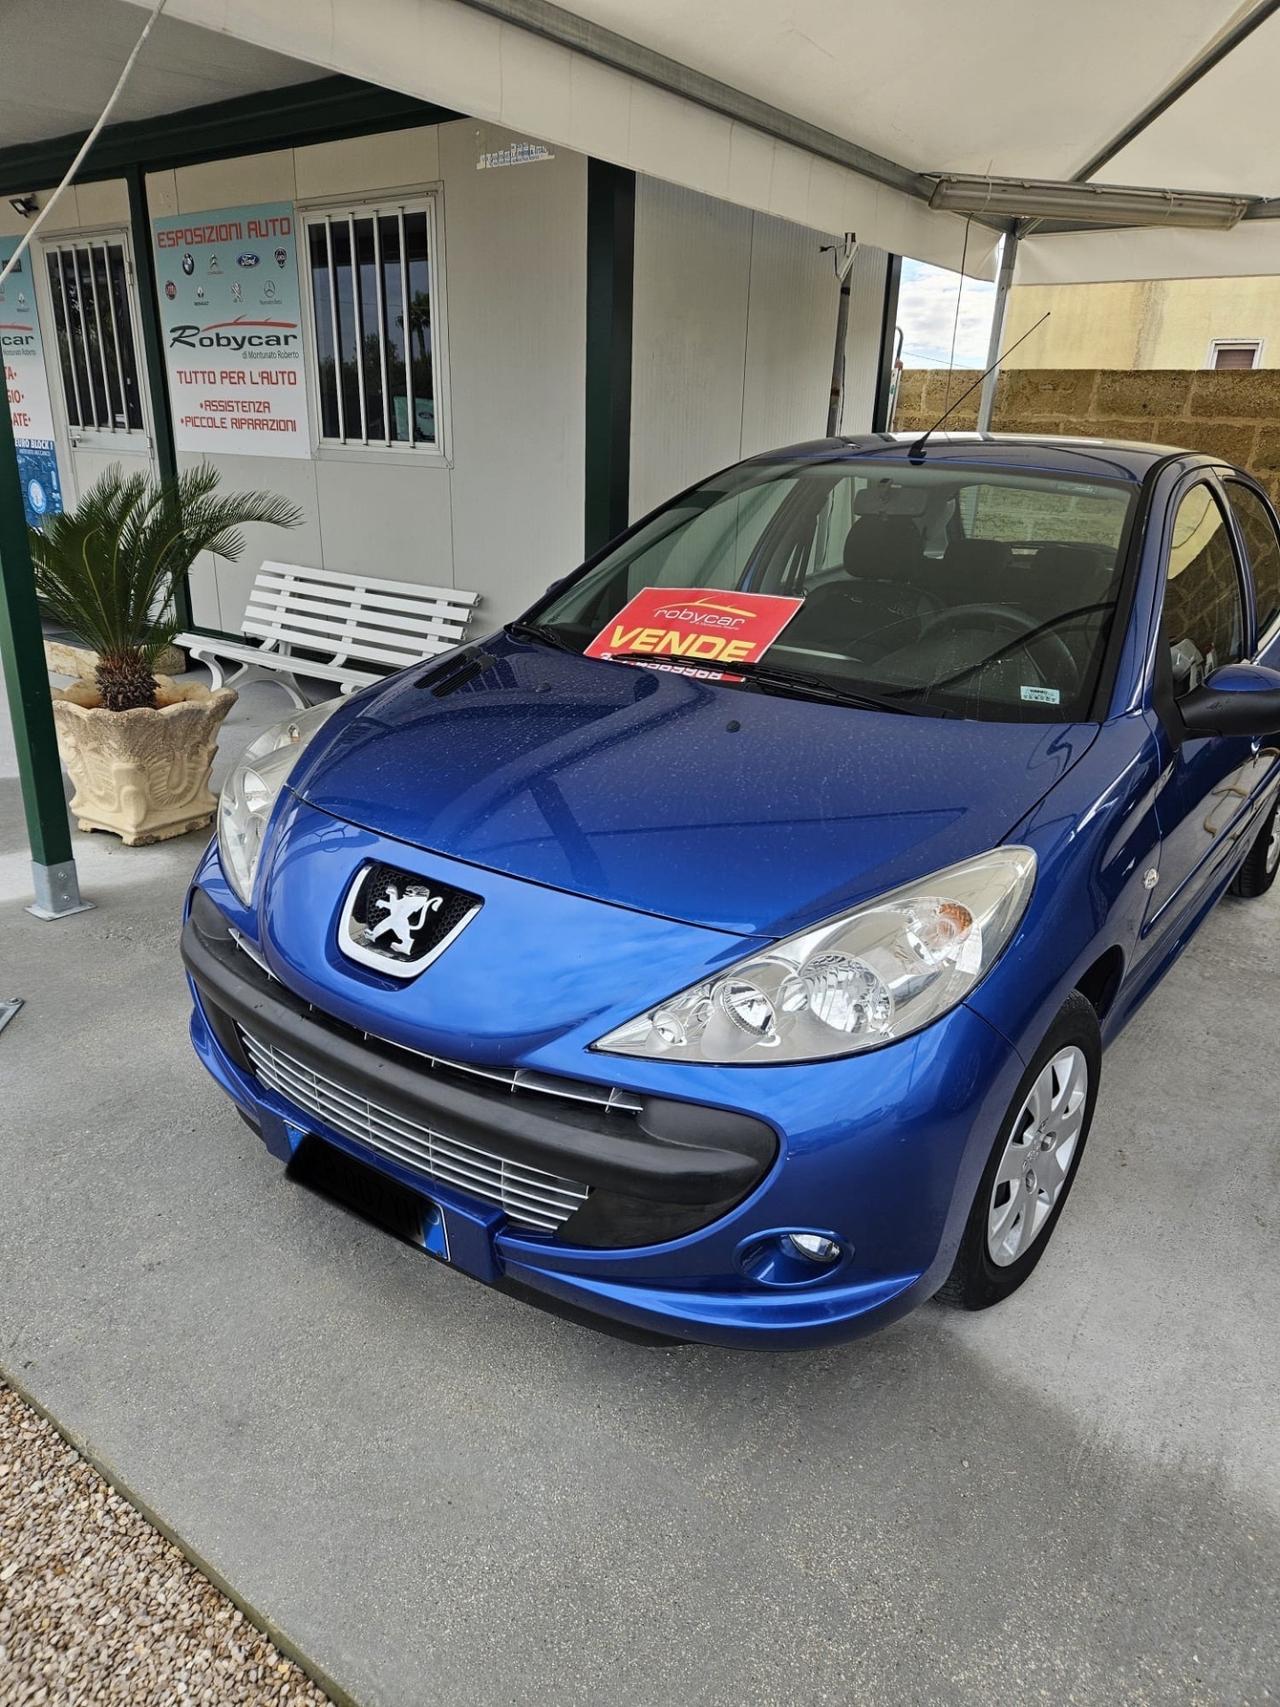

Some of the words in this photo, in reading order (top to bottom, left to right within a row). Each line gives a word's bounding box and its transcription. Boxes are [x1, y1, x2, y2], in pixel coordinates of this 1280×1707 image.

[157, 222, 243, 248] ESPOSIZIONI
[247, 217, 291, 240] AUTO
[169, 325, 298, 351] Robycar
[277, 350, 300, 359] Roberto
[176, 371, 216, 385] TUTTO
[220, 371, 247, 385] PER
[250, 371, 297, 386] L'AUTO
[231, 418, 297, 432] RIPARAZIONI
[654, 608, 745, 627] robycar
[609, 625, 756, 662] VENDE
